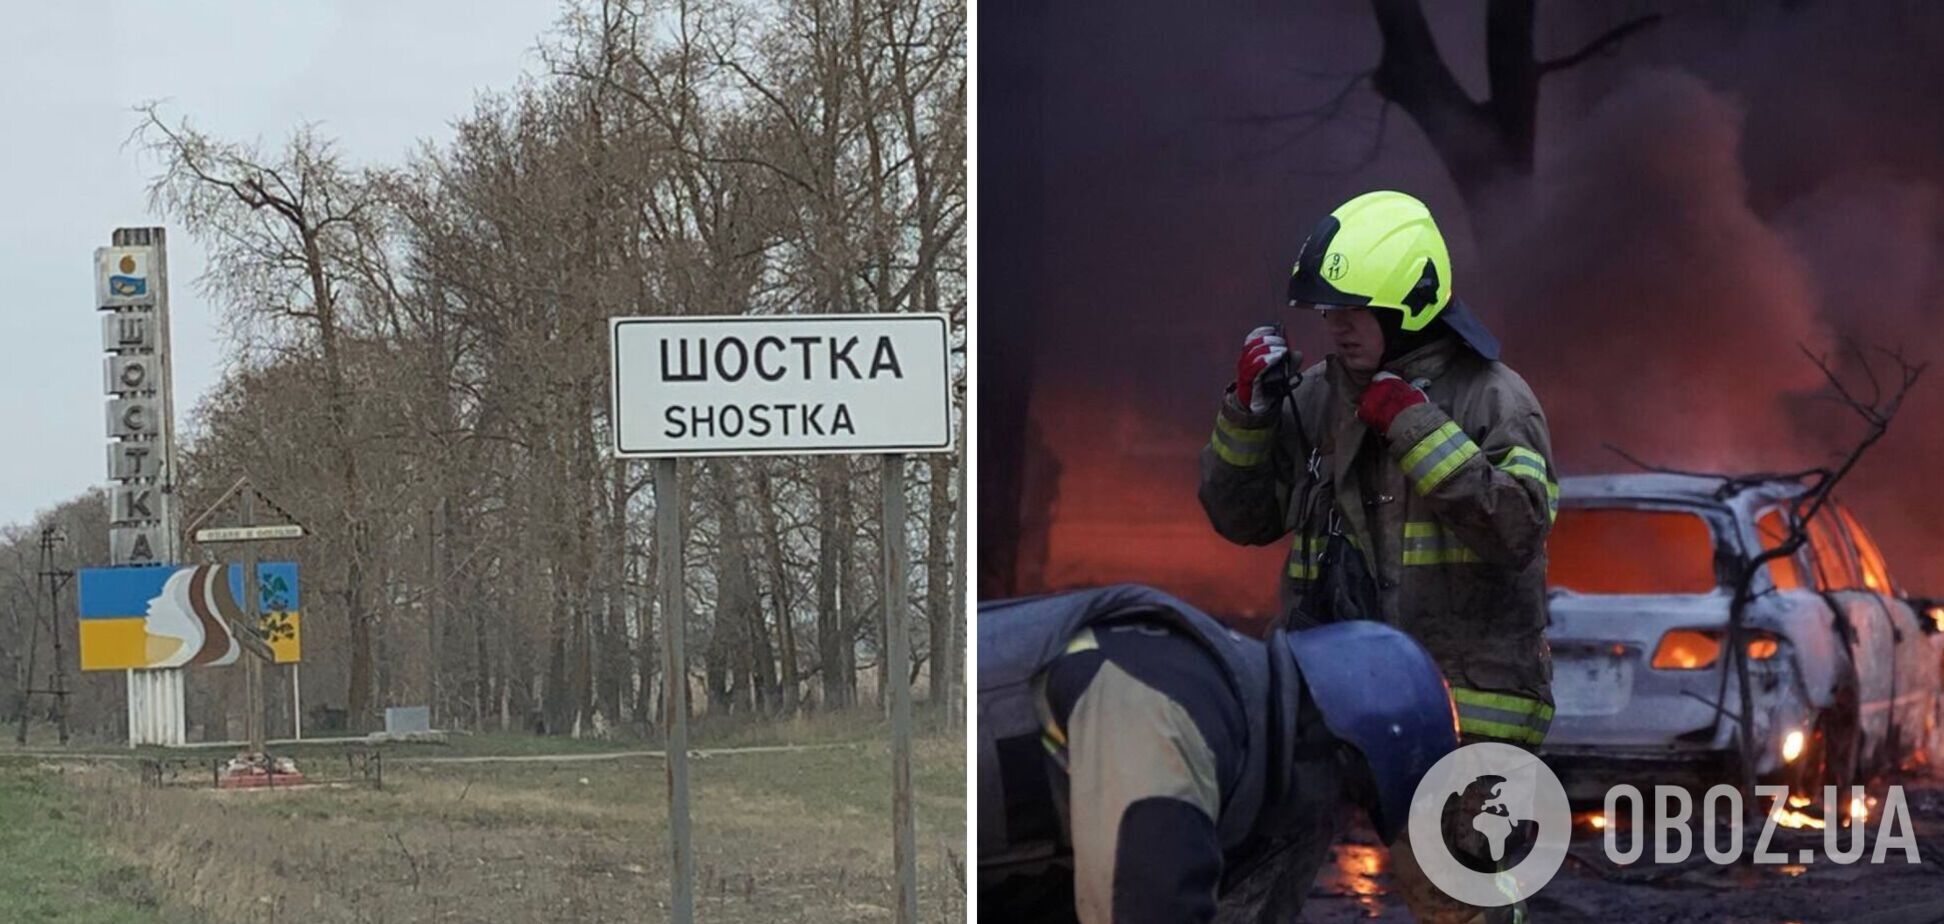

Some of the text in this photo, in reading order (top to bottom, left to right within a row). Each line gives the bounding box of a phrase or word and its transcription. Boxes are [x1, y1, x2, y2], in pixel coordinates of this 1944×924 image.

[1328, 266, 1340, 279] 11
[1333, 253, 1340, 266] 9
[659, 335, 904, 383] ШОСТКА
[663, 403, 856, 438] SHOSTKA
[118, 317, 154, 562] ШОСТКА
